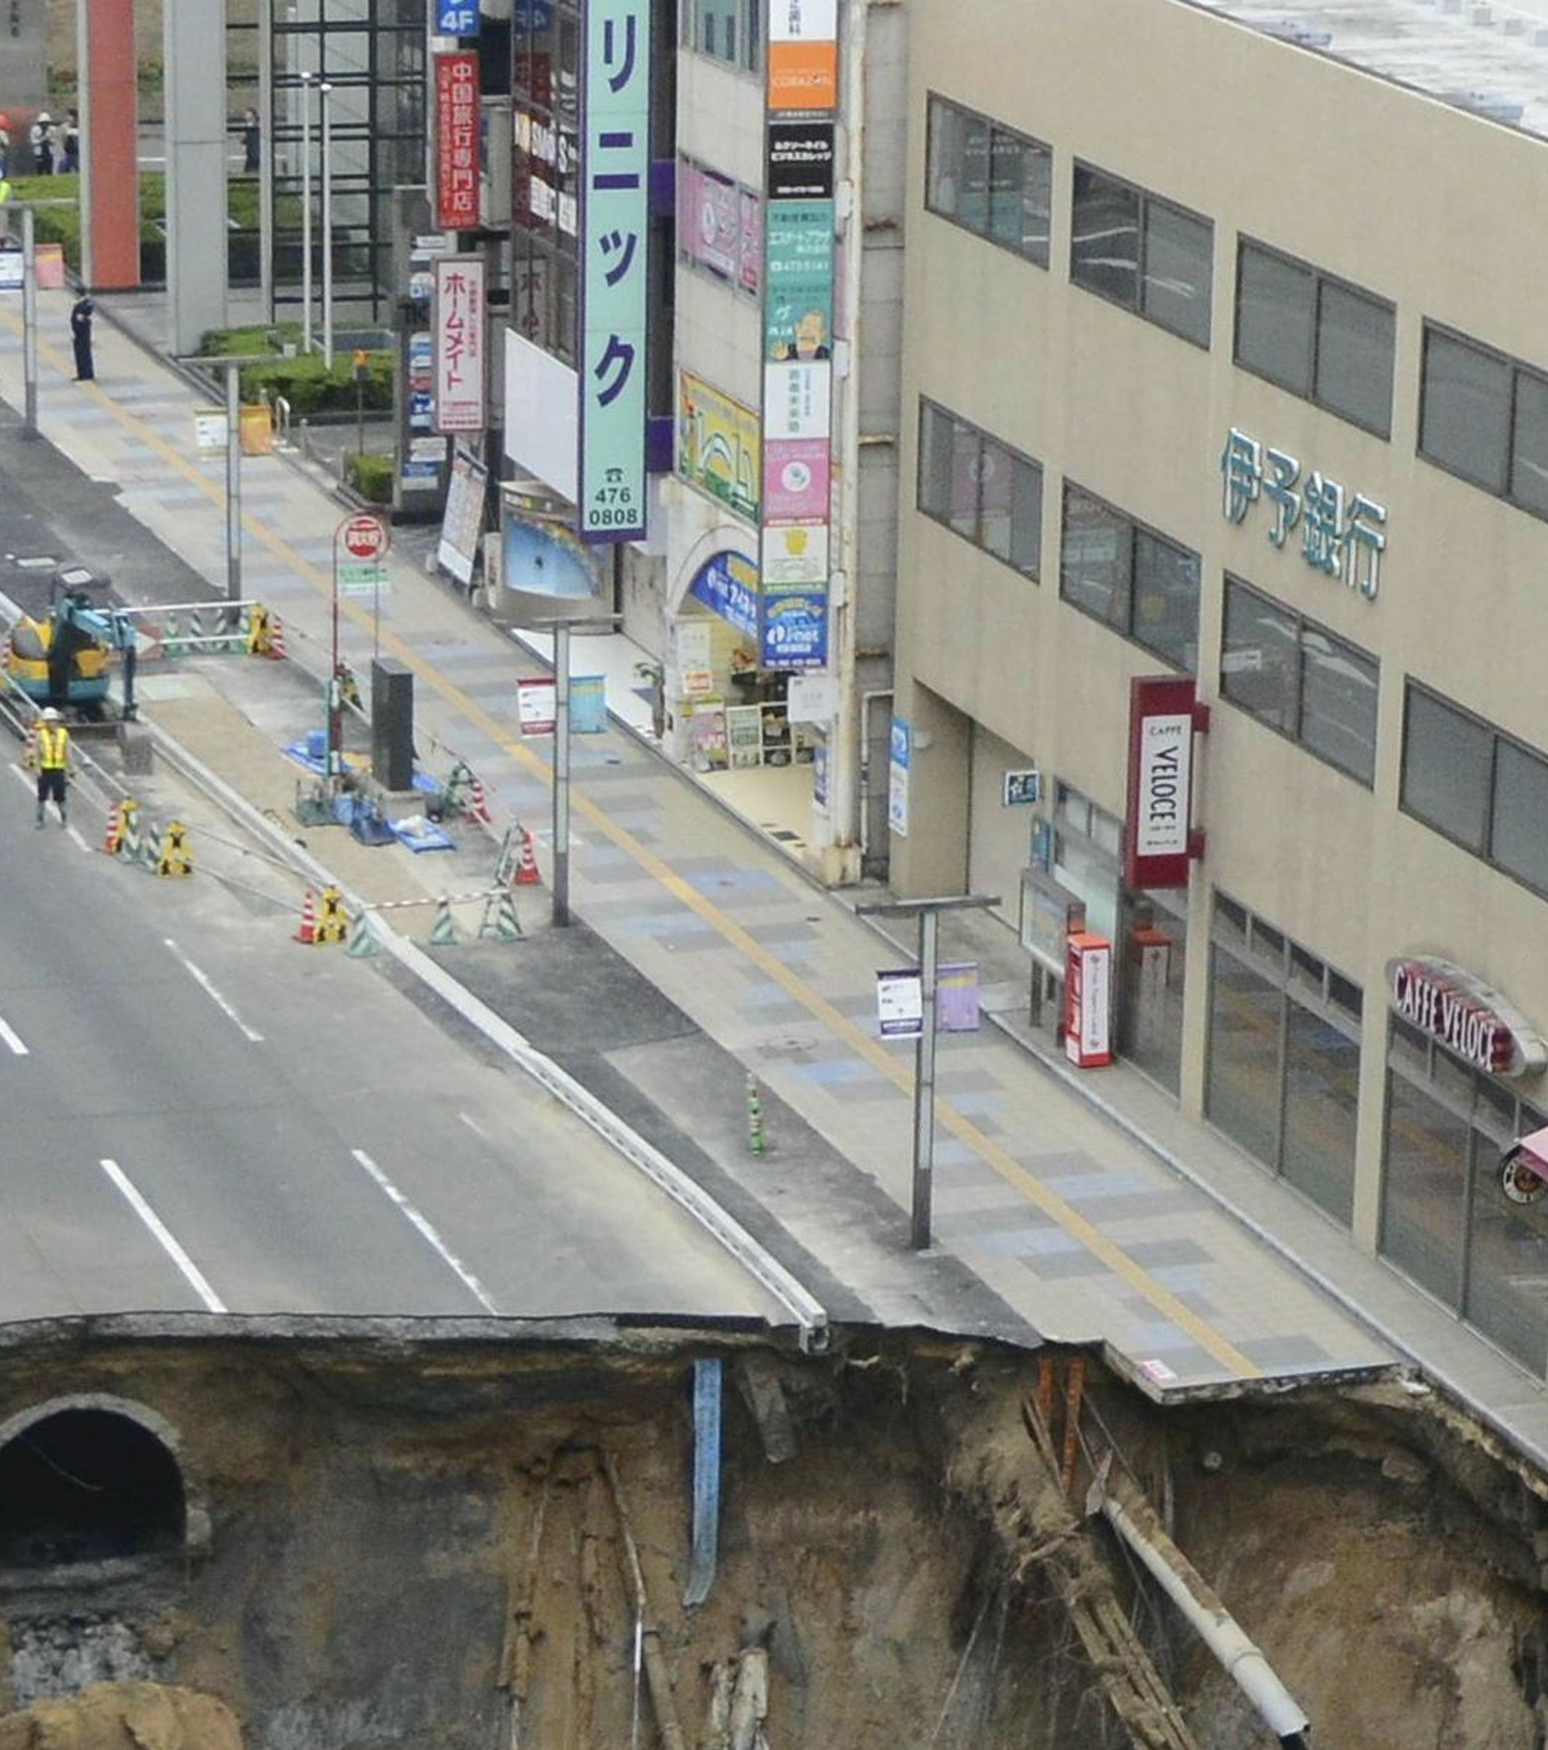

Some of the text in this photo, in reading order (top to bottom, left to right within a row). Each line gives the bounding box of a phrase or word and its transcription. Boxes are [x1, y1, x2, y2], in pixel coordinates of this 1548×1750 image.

[441, 11, 474, 31] 4F
[592, 14, 640, 408] リニック
[444, 271, 466, 391] ホームメイト
[589, 508, 639, 526] 0808
[595, 488, 632, 505] 476
[1220, 427, 1387, 599] 伊予銀行
[1149, 745, 1179, 822] VELOCE
[1394, 964, 1497, 1073] CAFFE VELOCE
